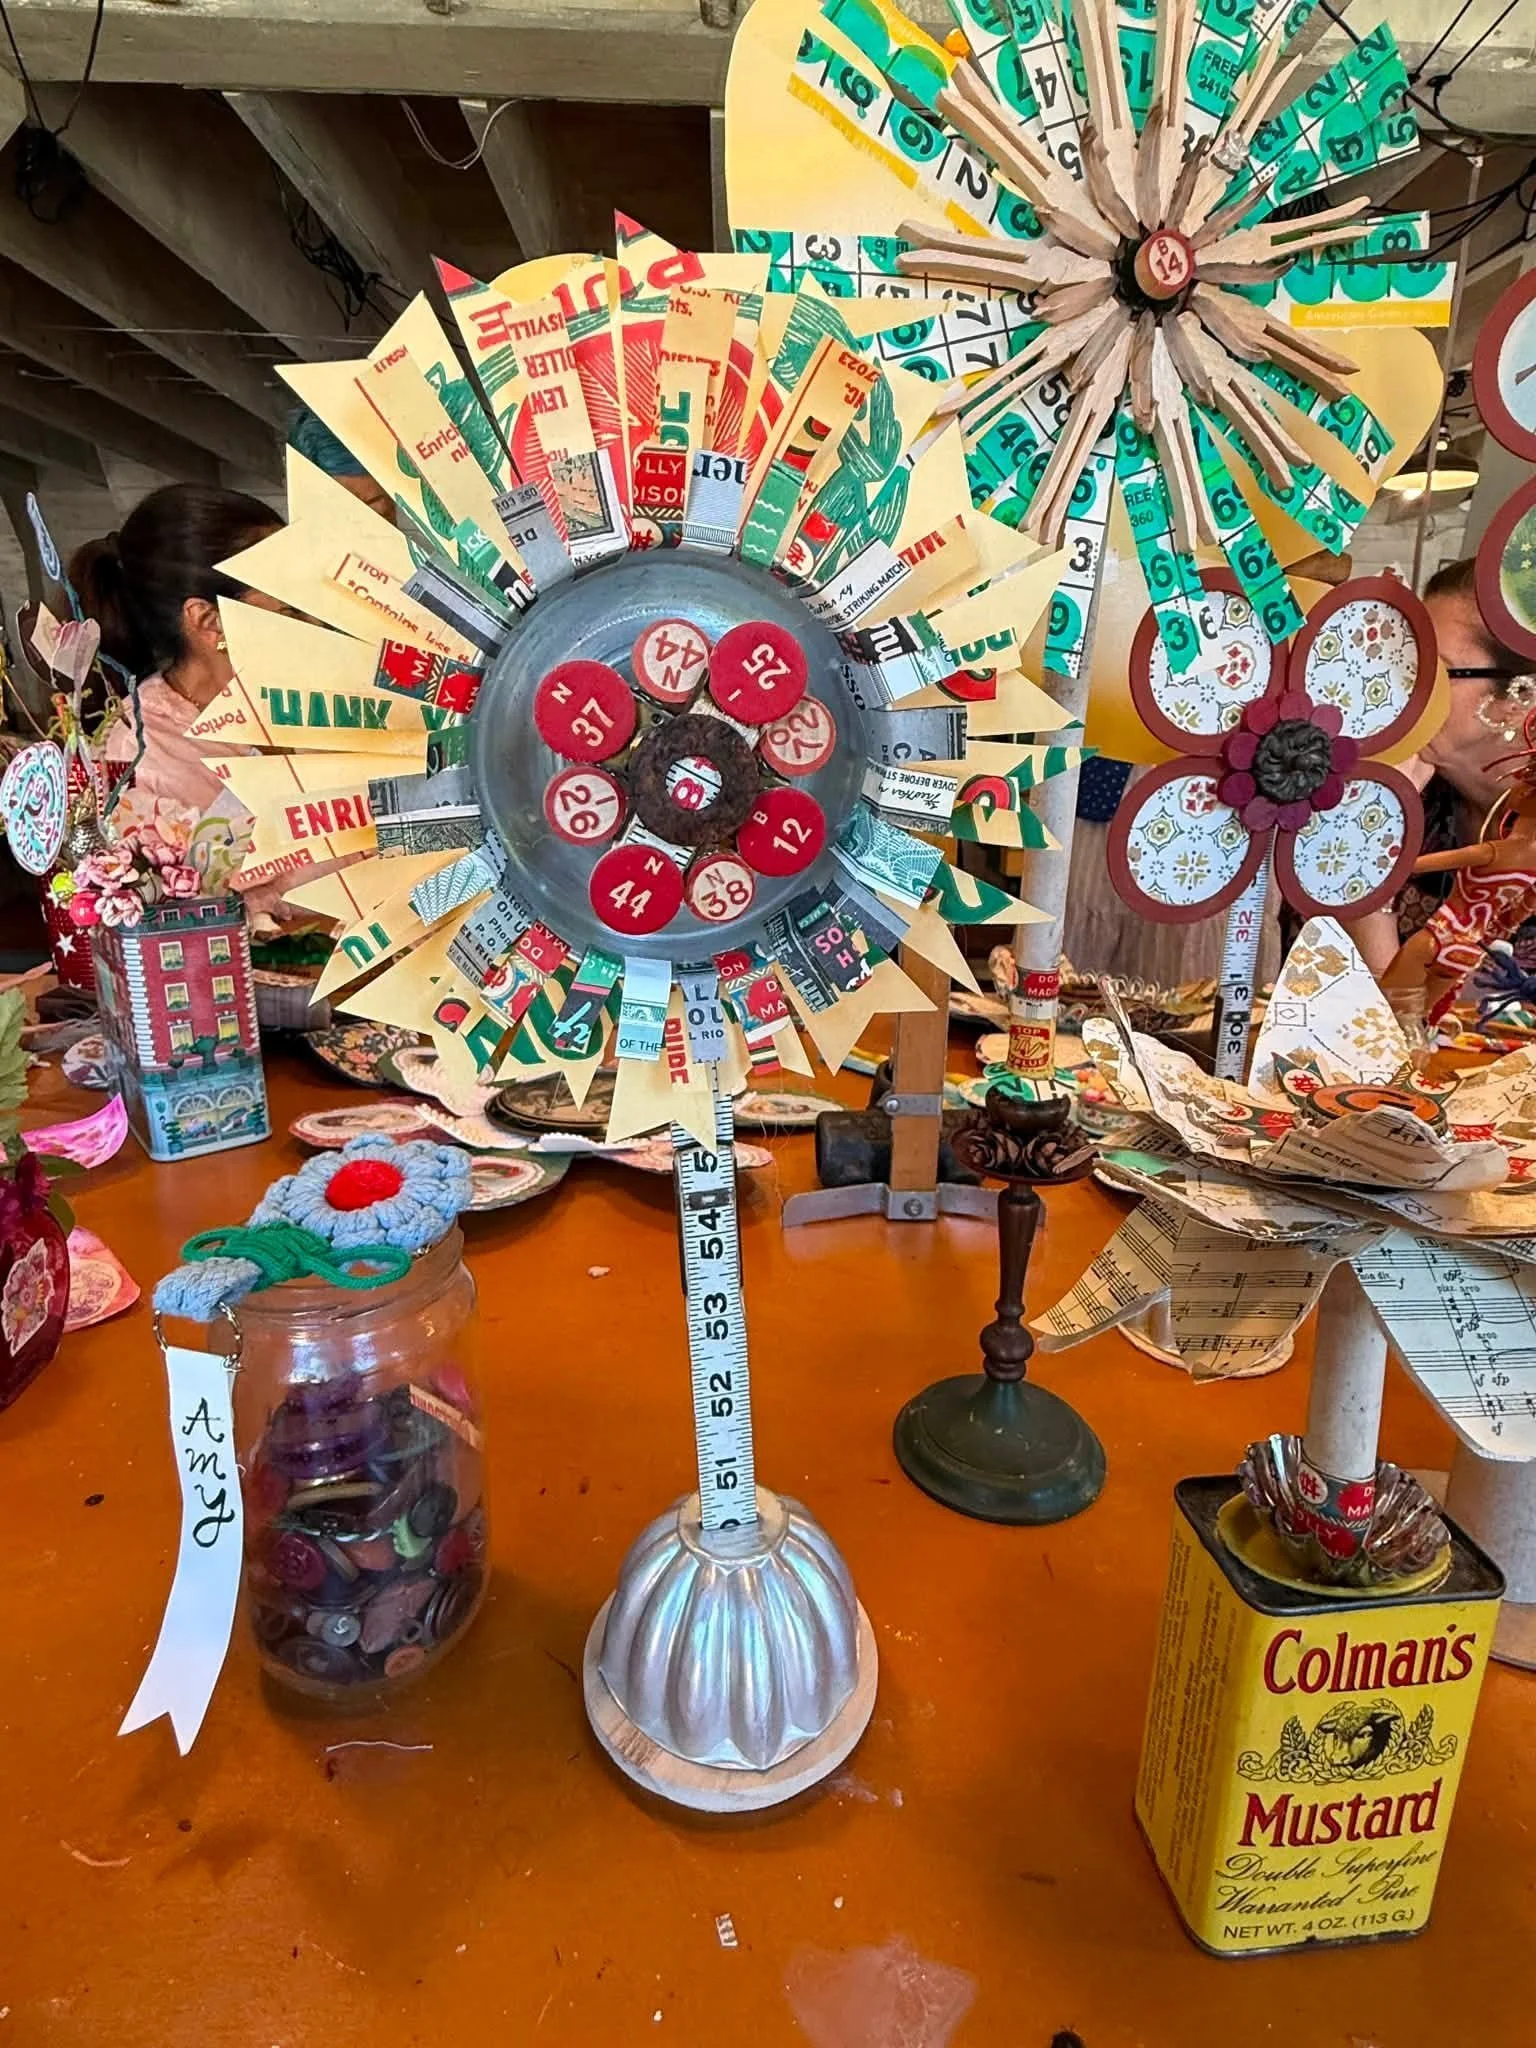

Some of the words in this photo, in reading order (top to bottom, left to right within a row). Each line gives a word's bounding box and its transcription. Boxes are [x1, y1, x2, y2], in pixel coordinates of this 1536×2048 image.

[1203, 49, 1237, 79] FREE
[1034, 67, 1059, 108] 4
[1197, 75, 1228, 100] 2418
[1306, 72, 1337, 109] 2
[1388, 116, 1416, 144] 5
[954, 156, 989, 200] 2
[1057, 142, 1084, 182] 5
[1279, 161, 1309, 195] 4
[1009, 203, 1042, 239] 3
[805, 234, 842, 262] 3
[1157, 240, 1169, 256] B
[1154, 249, 1183, 282] 14
[956, 303, 993, 327] 7
[966, 342, 999, 369] 7
[1119, 423, 1139, 457] 9
[1312, 515, 1340, 545] 3
[1069, 536, 1092, 572] 3
[844, 583, 882, 617] STRIKING
[878, 560, 906, 593] MATCH
[1153, 555, 1174, 588] 6
[1051, 599, 1070, 630] 9
[655, 630, 705, 671] 44
[1164, 616, 1190, 651] 3
[662, 665, 682, 690] N
[741, 642, 792, 691] 25
[551, 681, 574, 705] N
[570, 697, 616, 747] 37
[898, 773, 932, 788] BEFORE
[558, 783, 600, 836] 26
[752, 810, 769, 826] B
[772, 816, 814, 856] 12
[643, 855, 666, 877] N
[704, 867, 727, 887] N
[608, 879, 653, 919] 44
[700, 878, 751, 918] 38
[1235, 909, 1253, 943] 32
[720, 961, 744, 977] ON
[619, 1037, 638, 1050] OF
[1227, 1021, 1244, 1055] 30
[698, 1208, 724, 1260] 54
[704, 1292, 729, 1340] 53
[709, 1370, 733, 1417] 52
[715, 1456, 738, 1490] 51
[1264, 1623, 1477, 1695] Colman's
[1237, 1776, 1443, 1848] Mustard
[1215, 1852, 1321, 1884] Double
[1320, 1840, 1438, 1884] Superfine
[1215, 1883, 1361, 1916] Warranted
[1356, 1873, 1420, 1906] Pure
[1223, 1924, 1265, 1940] NET
[1267, 1922, 1297, 1937] WT.
[1301, 1919, 1314, 1932] 4
[1317, 1916, 1348, 1931] OZ.
[1351, 1913, 1388, 1930] (113
